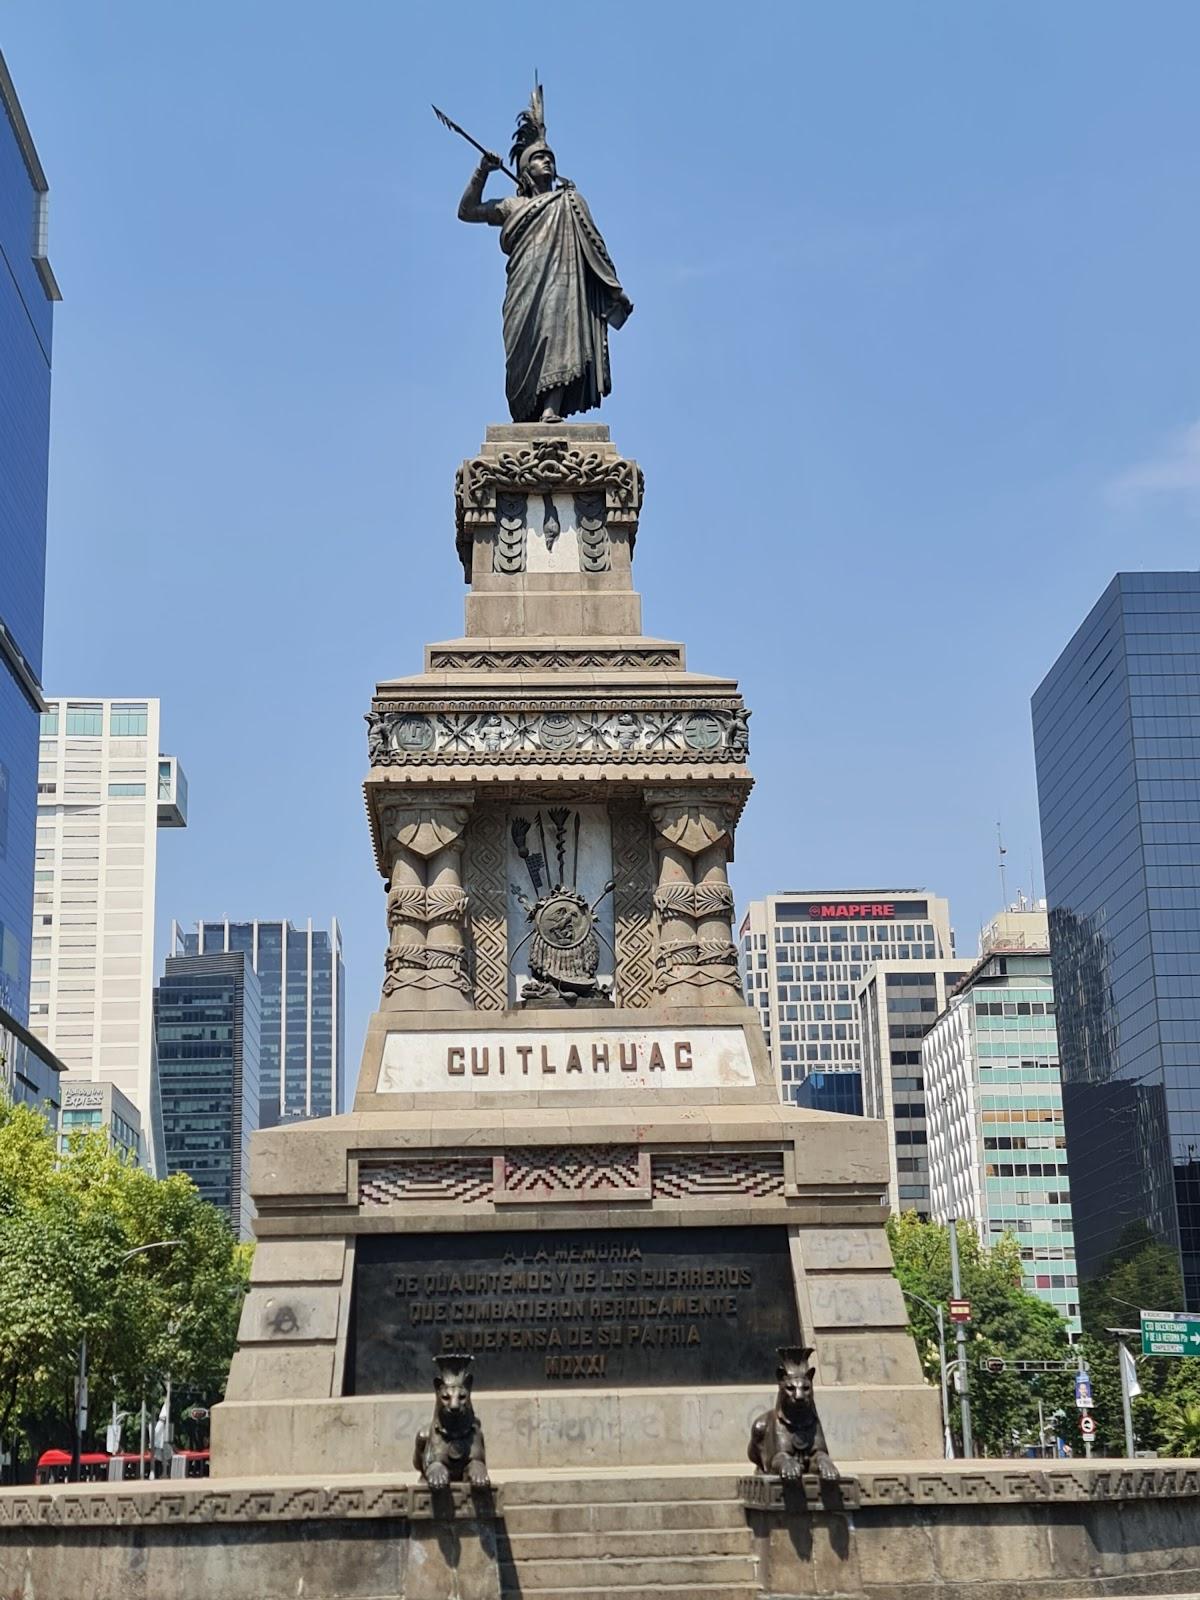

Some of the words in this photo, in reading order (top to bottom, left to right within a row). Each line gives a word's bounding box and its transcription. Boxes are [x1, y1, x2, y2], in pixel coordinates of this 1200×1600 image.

[821, 904, 895, 917] MAPFRE
[447, 1042, 693, 1076] CUITLAHUAC
[65, 1096, 103, 1107] Express
[503, 1243, 517, 1264] A
[522, 1241, 549, 1263] LA
[554, 1241, 643, 1262] MEMORIA
[394, 1273, 418, 1295] DE
[556, 1271, 568, 1292] Y
[573, 1270, 596, 1292] DE
[600, 1268, 638, 1290] LOS
[641, 1265, 752, 1289] GUERREROS
[409, 1302, 448, 1326] QUE
[451, 1299, 584, 1322] COMBATIERON
[590, 1296, 737, 1319] HEROICAMENTE
[441, 1329, 467, 1351] EN
[471, 1328, 562, 1350] DEFENSA
[567, 1327, 593, 1348] DE
[598, 1326, 622, 1346] SU
[628, 1325, 700, 1346] PATRIA
[545, 1355, 608, 1378] MDXXI
